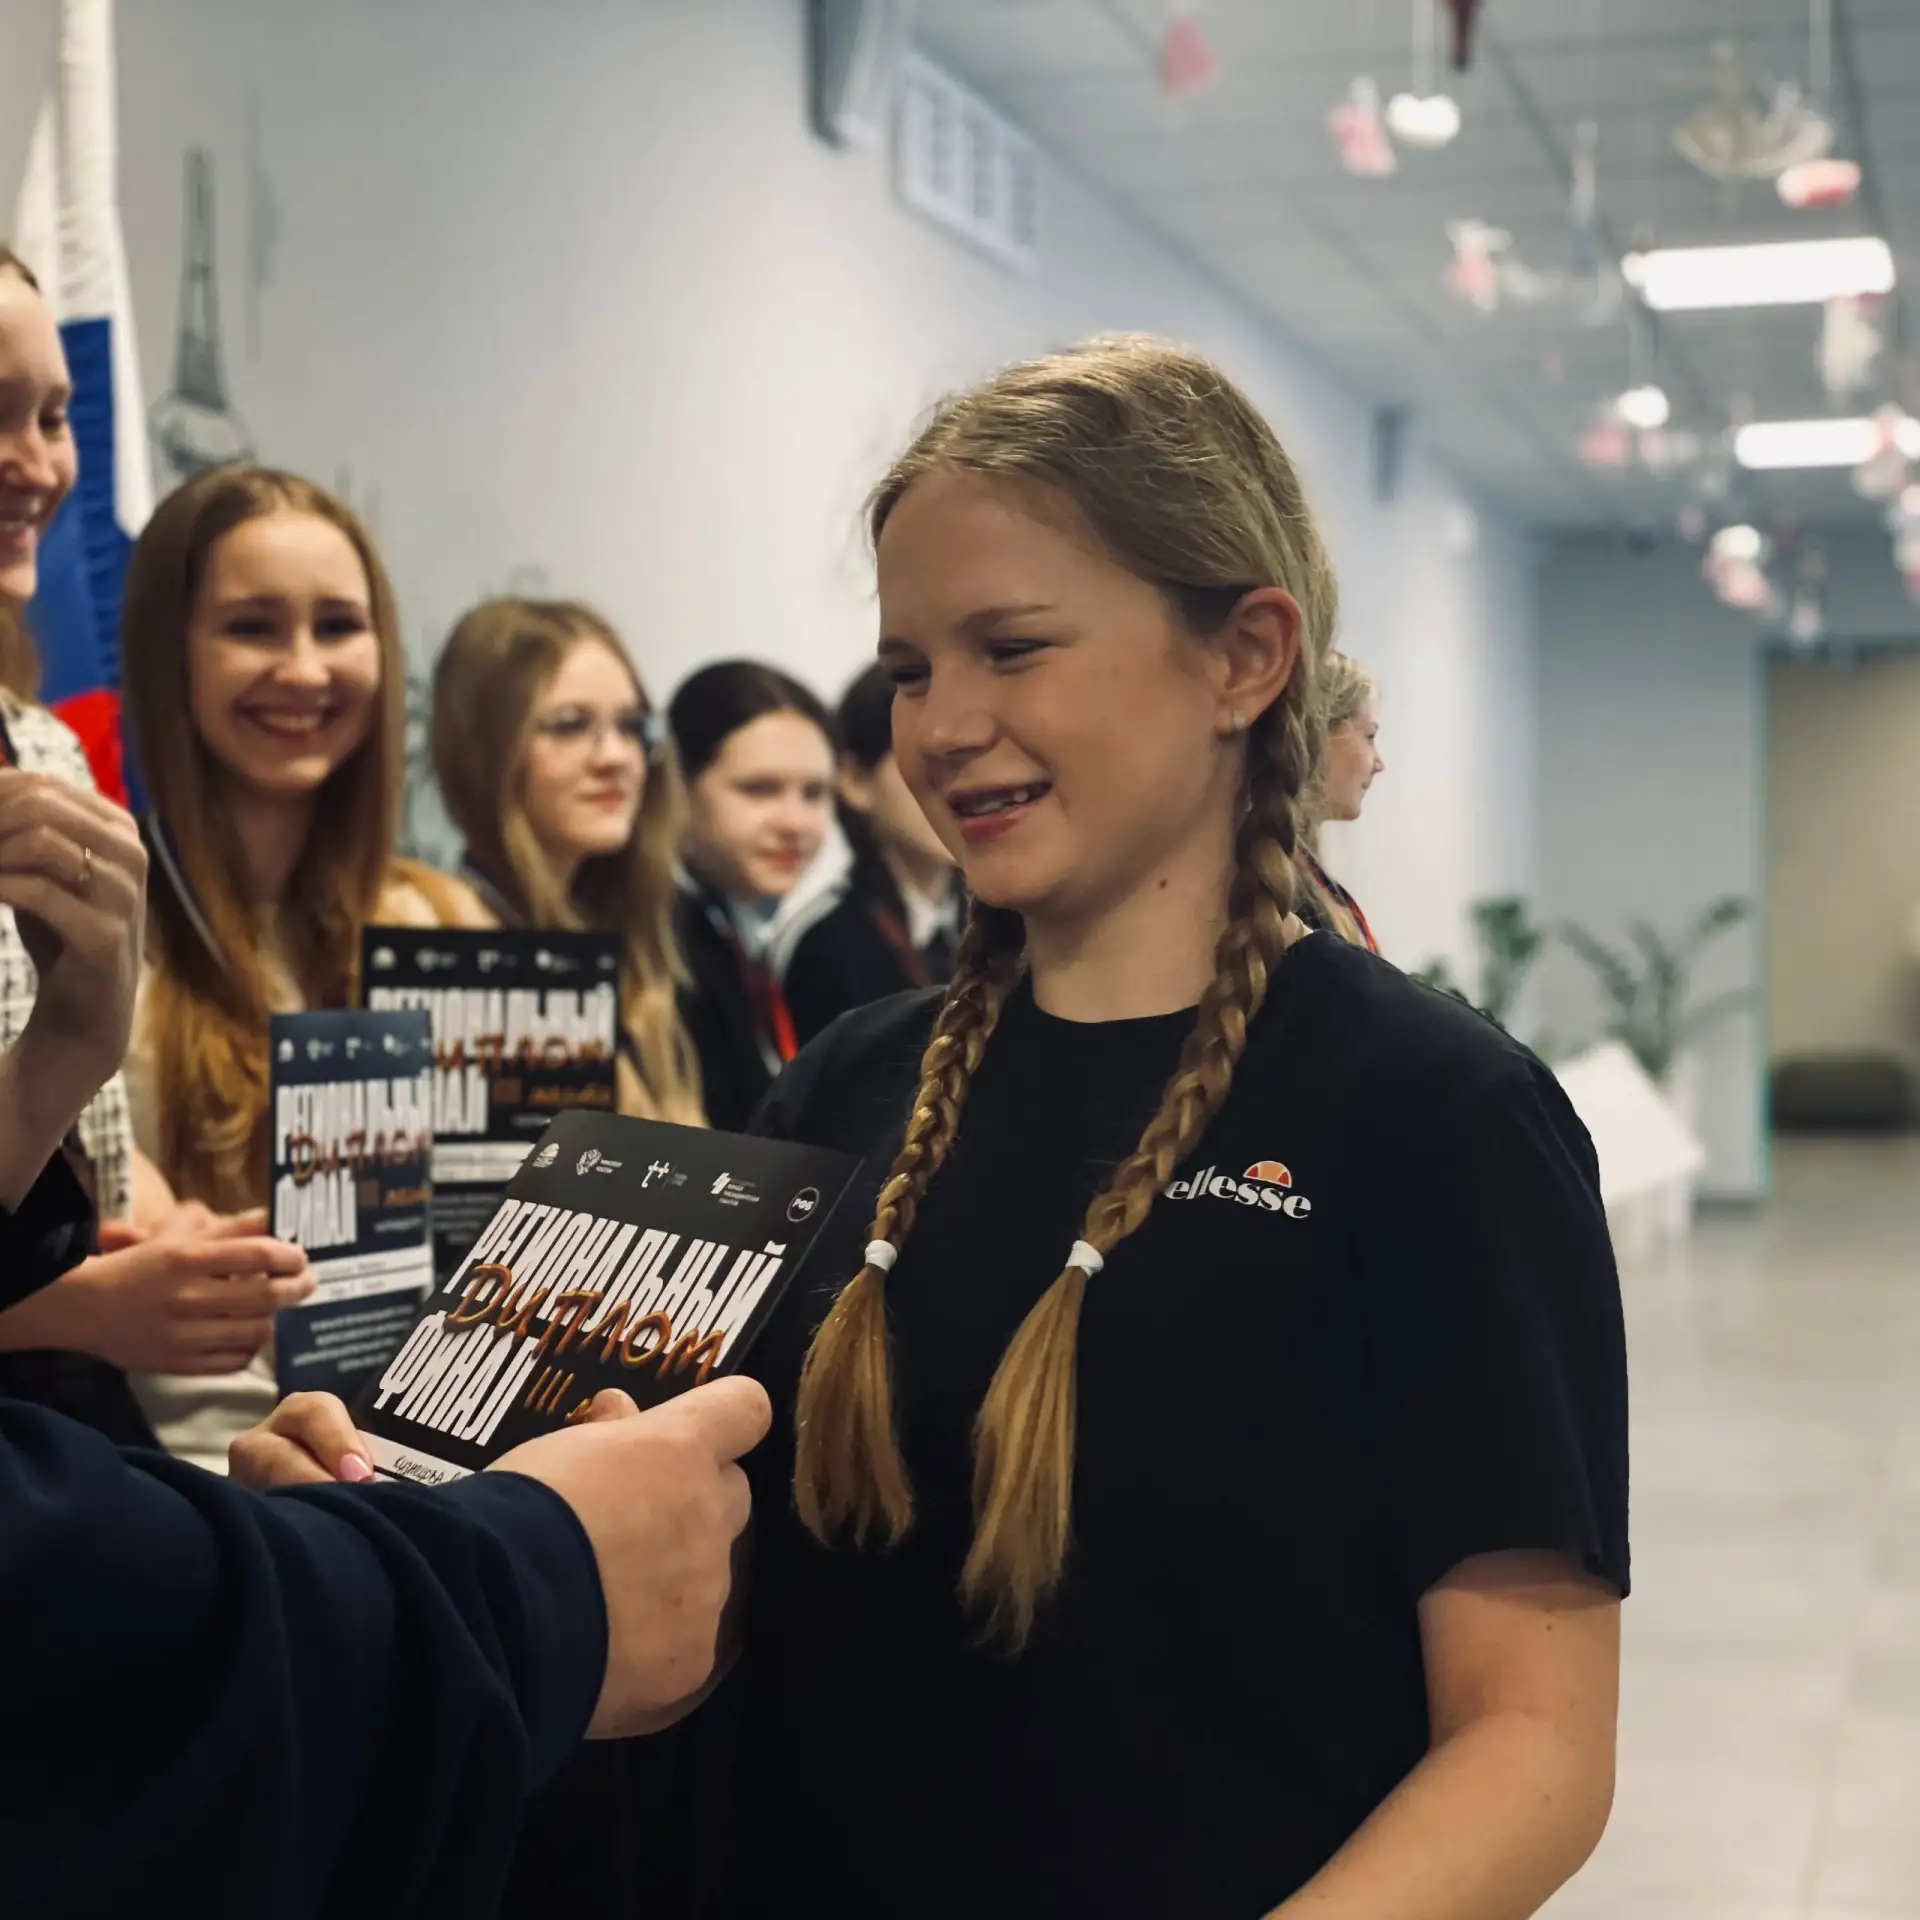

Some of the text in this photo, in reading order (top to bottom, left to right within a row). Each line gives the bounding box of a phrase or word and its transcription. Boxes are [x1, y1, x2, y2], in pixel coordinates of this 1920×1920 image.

[1164, 1164, 1312, 1219] ellesse
[442, 1198, 787, 1368] РЕГИОНАЛЬНЫЙ
[373, 1309, 541, 1447] ФИНАЛ
